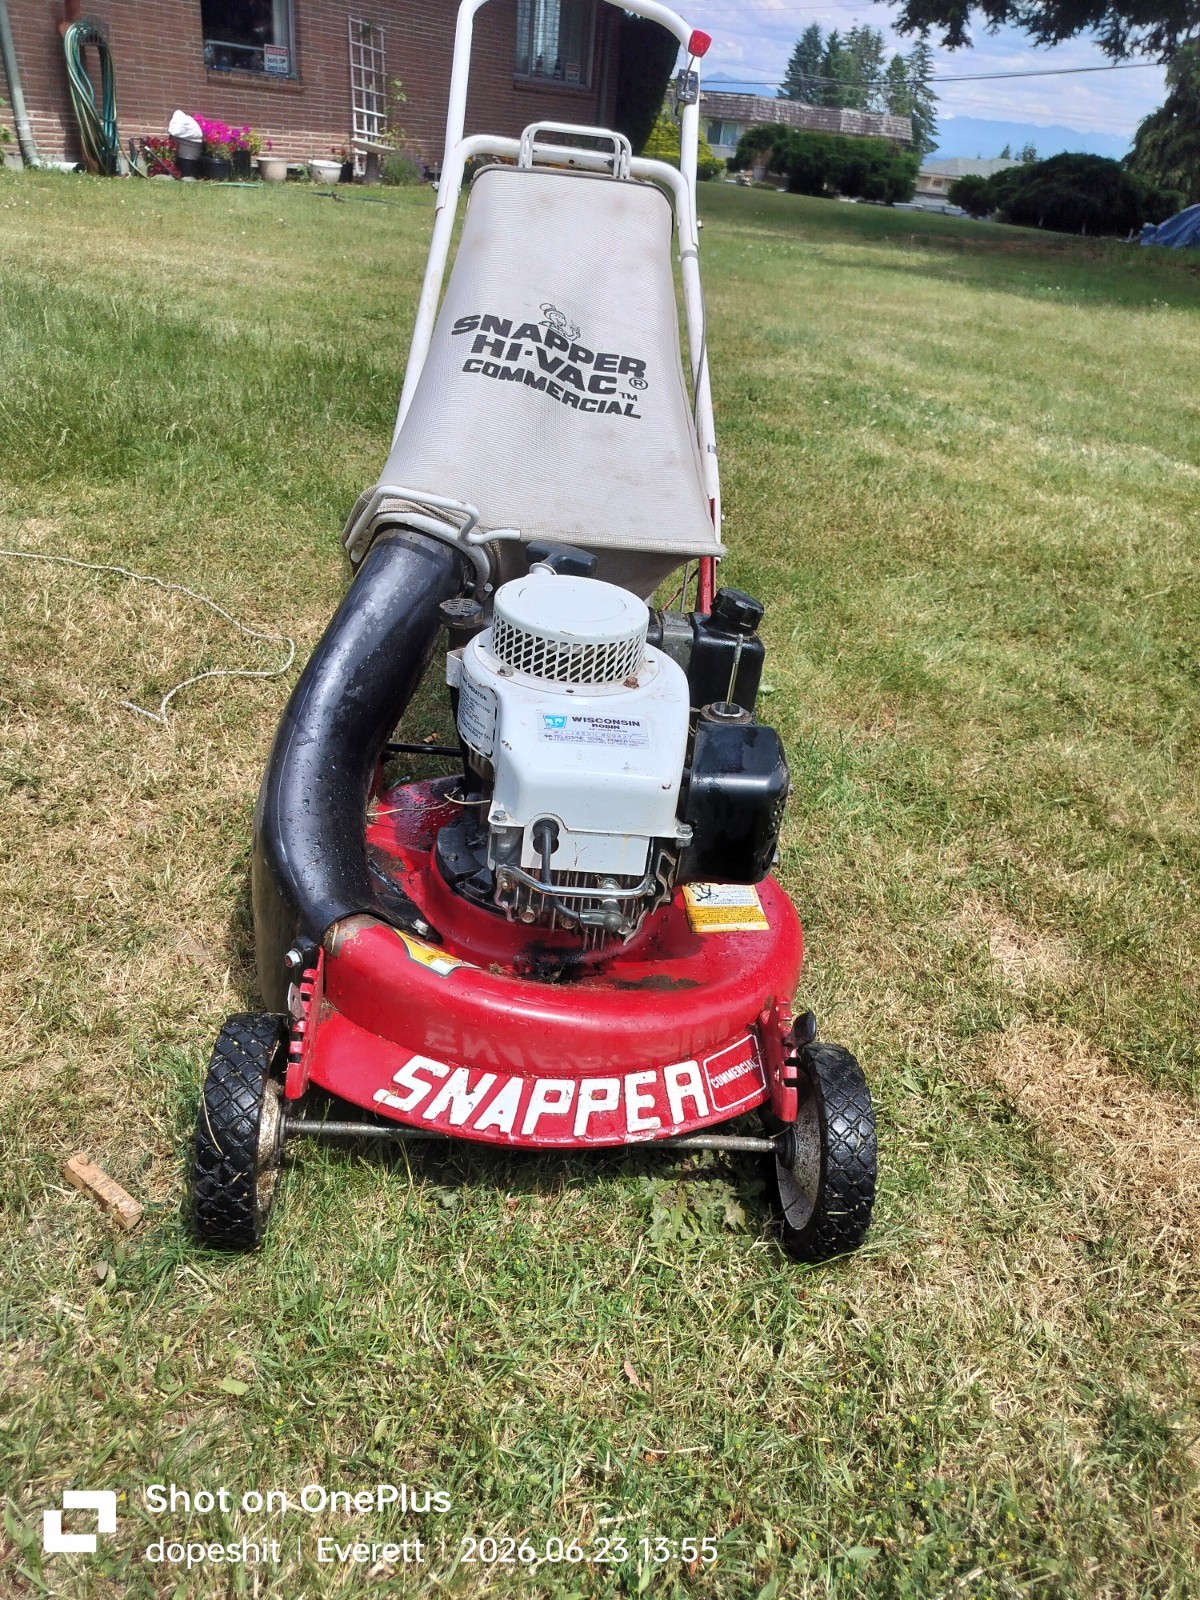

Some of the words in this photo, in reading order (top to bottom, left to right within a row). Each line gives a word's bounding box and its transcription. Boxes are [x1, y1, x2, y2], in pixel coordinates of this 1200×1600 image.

[451, 314, 647, 378] SNAPPER
[471, 334, 618, 394] HI-VAC
[462, 358, 642, 419] COMMERCIAL
[571, 716, 640, 727] WISCONSIN
[373, 1055, 709, 1137] SNAPPER
[710, 1058, 760, 1089] COMMERCIAL
